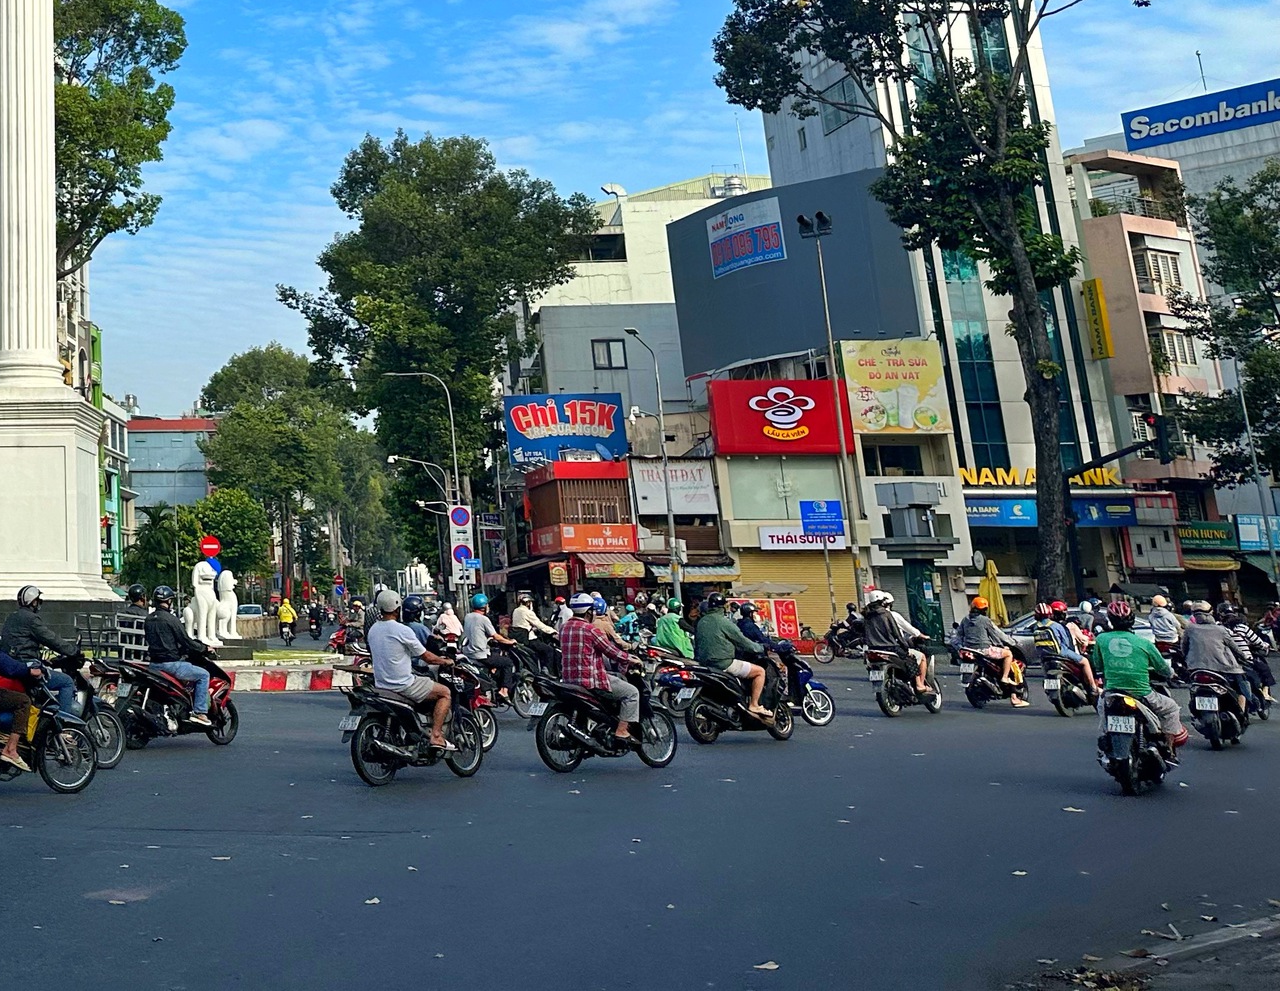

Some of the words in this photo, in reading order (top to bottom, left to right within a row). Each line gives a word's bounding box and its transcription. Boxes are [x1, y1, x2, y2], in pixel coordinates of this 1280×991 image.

[1130, 90, 1280, 140] Sacombank
[754, 225, 780, 253] 795
[510, 398, 559, 432] Chỉ
[563, 399, 618, 432] 15K
[551, 421, 573, 436] SỮA
[576, 423, 607, 436] NGON
[958, 467, 1020, 486] NAM
[1068, 467, 1123, 486] ANK
[586, 537, 604, 547] THỌ
[606, 536, 629, 546] PHÁT
[768, 531, 797, 544] THÁI
